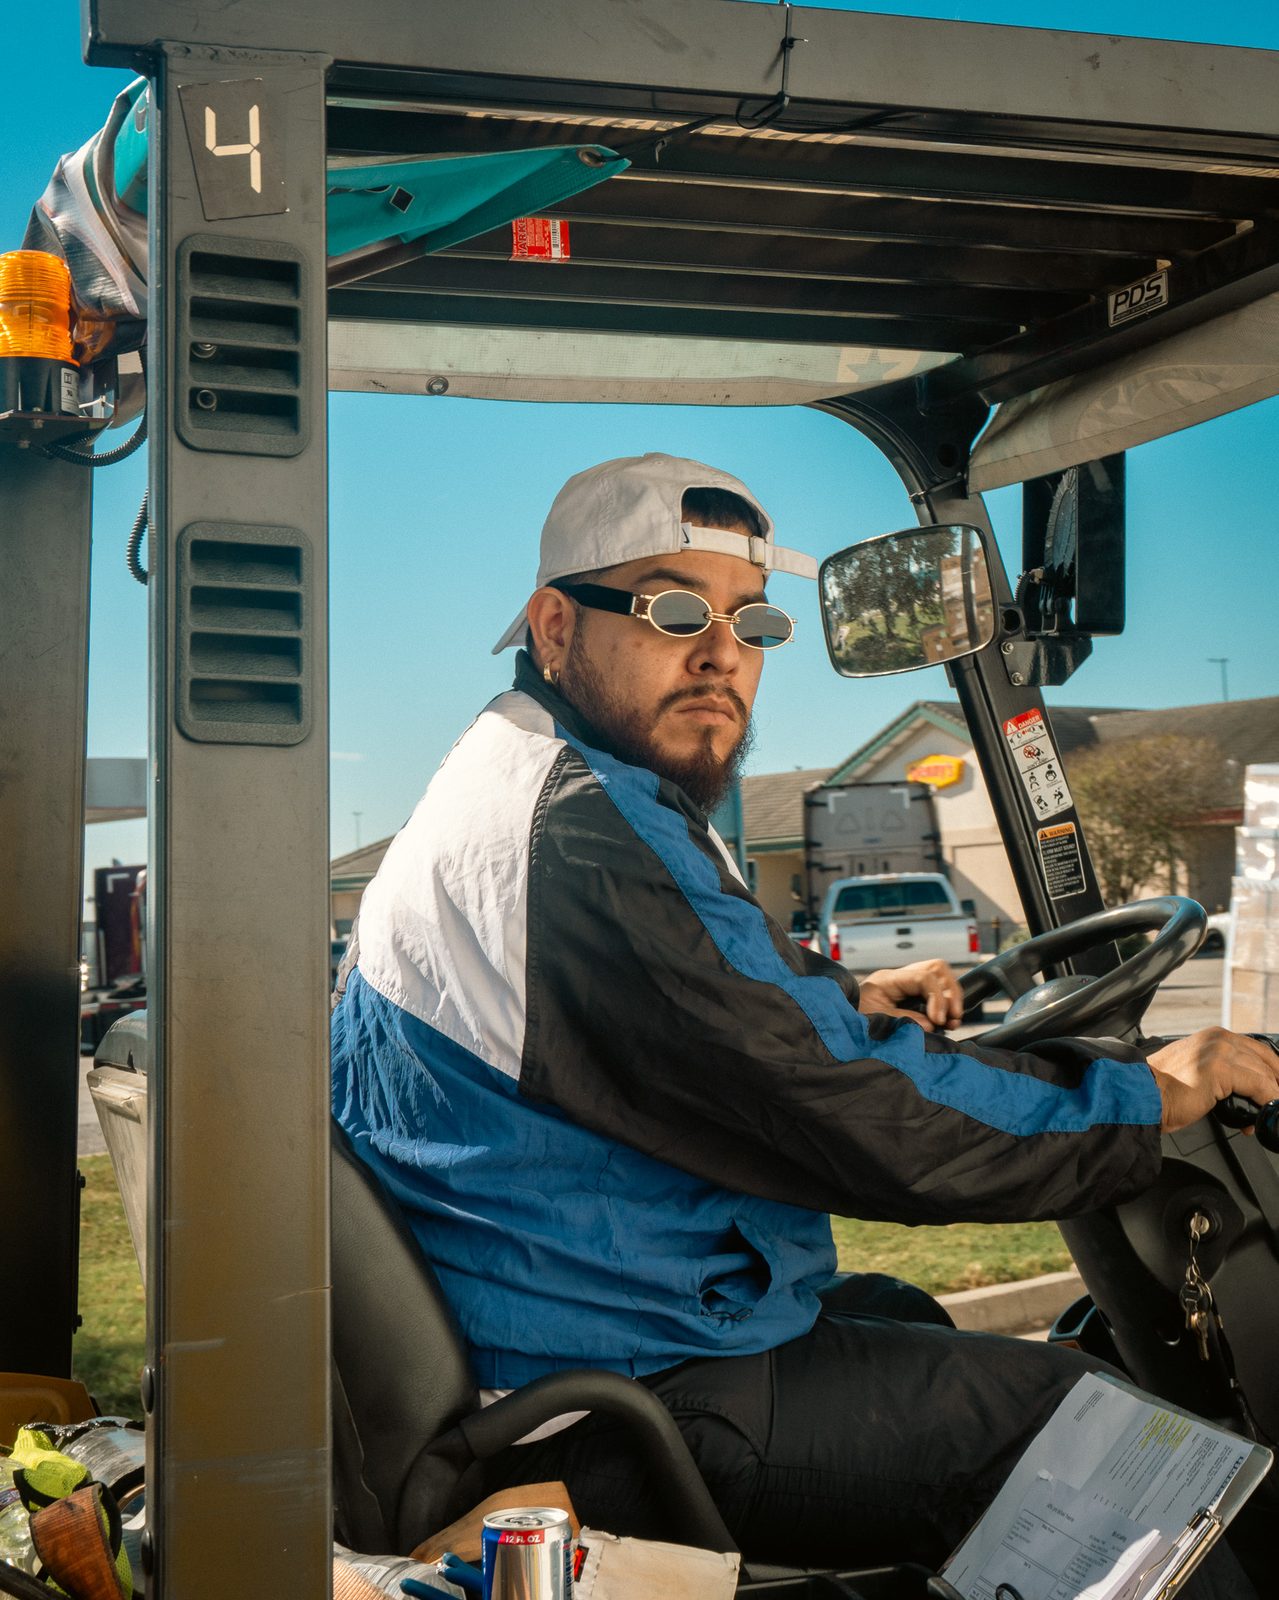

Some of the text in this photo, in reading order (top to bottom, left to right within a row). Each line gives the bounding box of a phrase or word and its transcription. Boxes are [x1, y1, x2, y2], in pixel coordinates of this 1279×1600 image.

[205, 104, 262, 194] 4
[1113, 275, 1163, 315] PDS
[505, 1535, 514, 1543] 12
[527, 1535, 540, 1543] OZ
